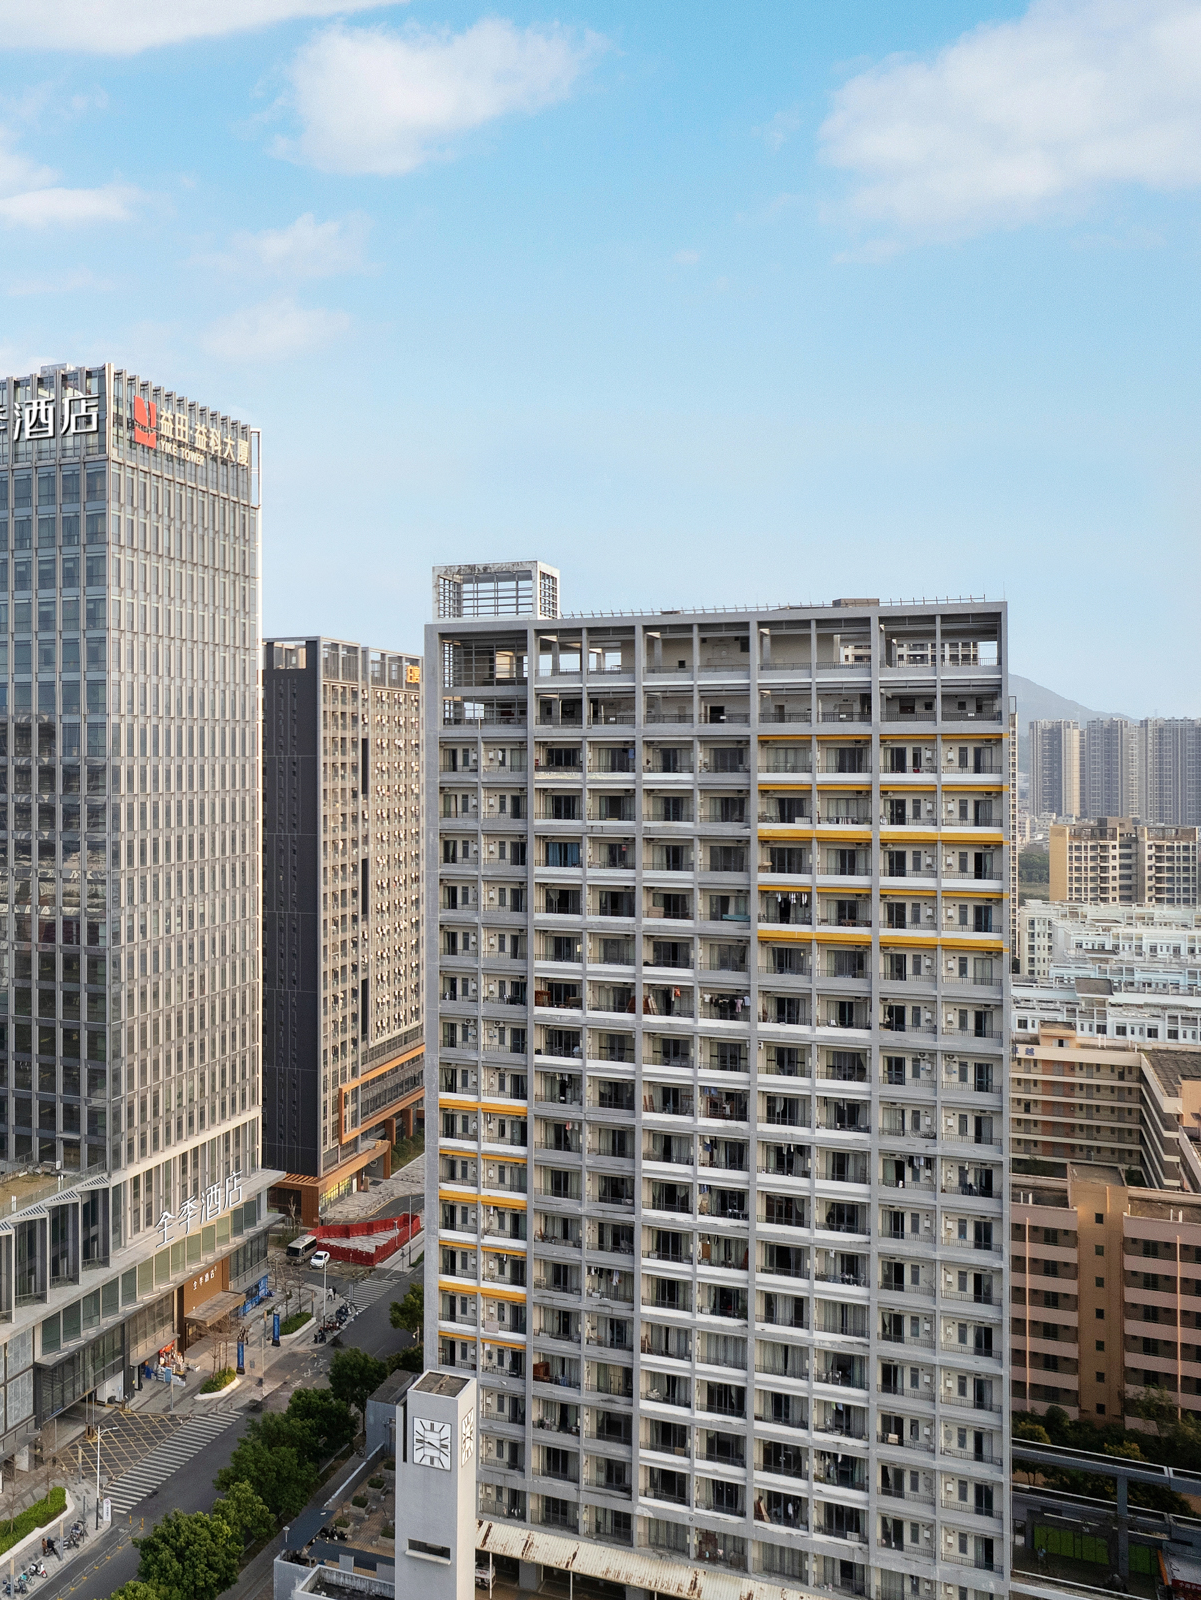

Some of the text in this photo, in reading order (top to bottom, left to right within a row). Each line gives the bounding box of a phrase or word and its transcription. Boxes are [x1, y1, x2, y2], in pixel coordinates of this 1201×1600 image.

[160, 440, 205, 466] YIKE TOWER
[155, 1170, 243, 1248] 全季酒店
